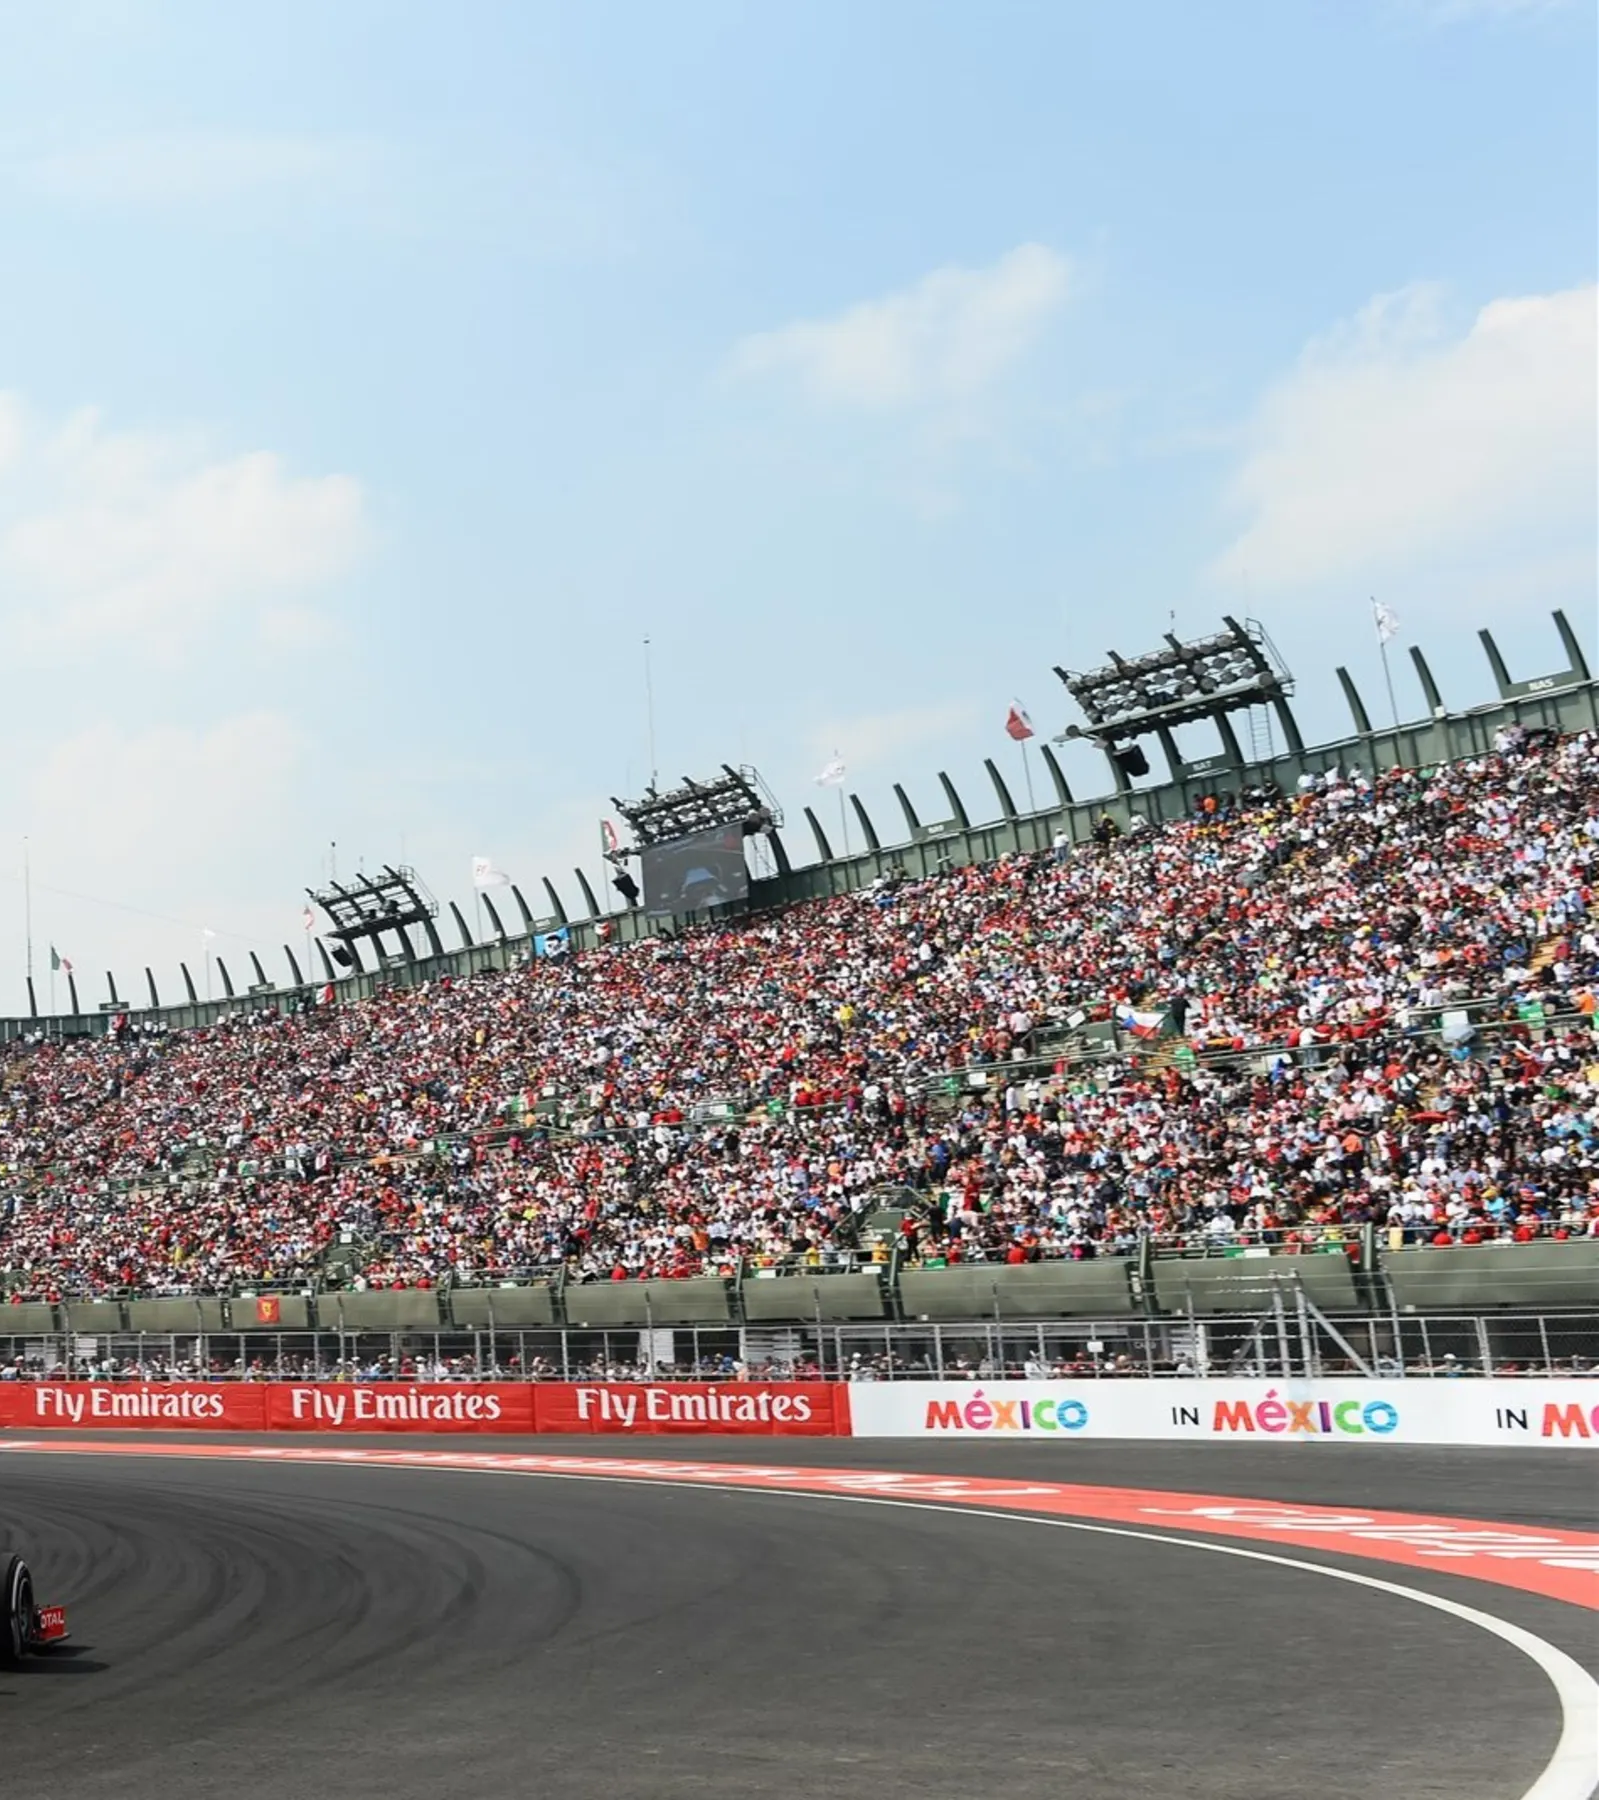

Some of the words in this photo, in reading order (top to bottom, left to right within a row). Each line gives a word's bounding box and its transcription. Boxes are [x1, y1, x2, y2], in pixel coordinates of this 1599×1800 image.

[35, 1387, 86, 1422] Fly
[90, 1386, 225, 1418] Emirates
[291, 1388, 346, 1425] Fly
[354, 1387, 501, 1420] Emirates
[576, 1388, 637, 1427] Fly
[645, 1387, 813, 1422] Emirates
[1172, 1407, 1199, 1426] IN
[1496, 1409, 1528, 1429] IN
[41, 1612, 64, 1628] OTAL
